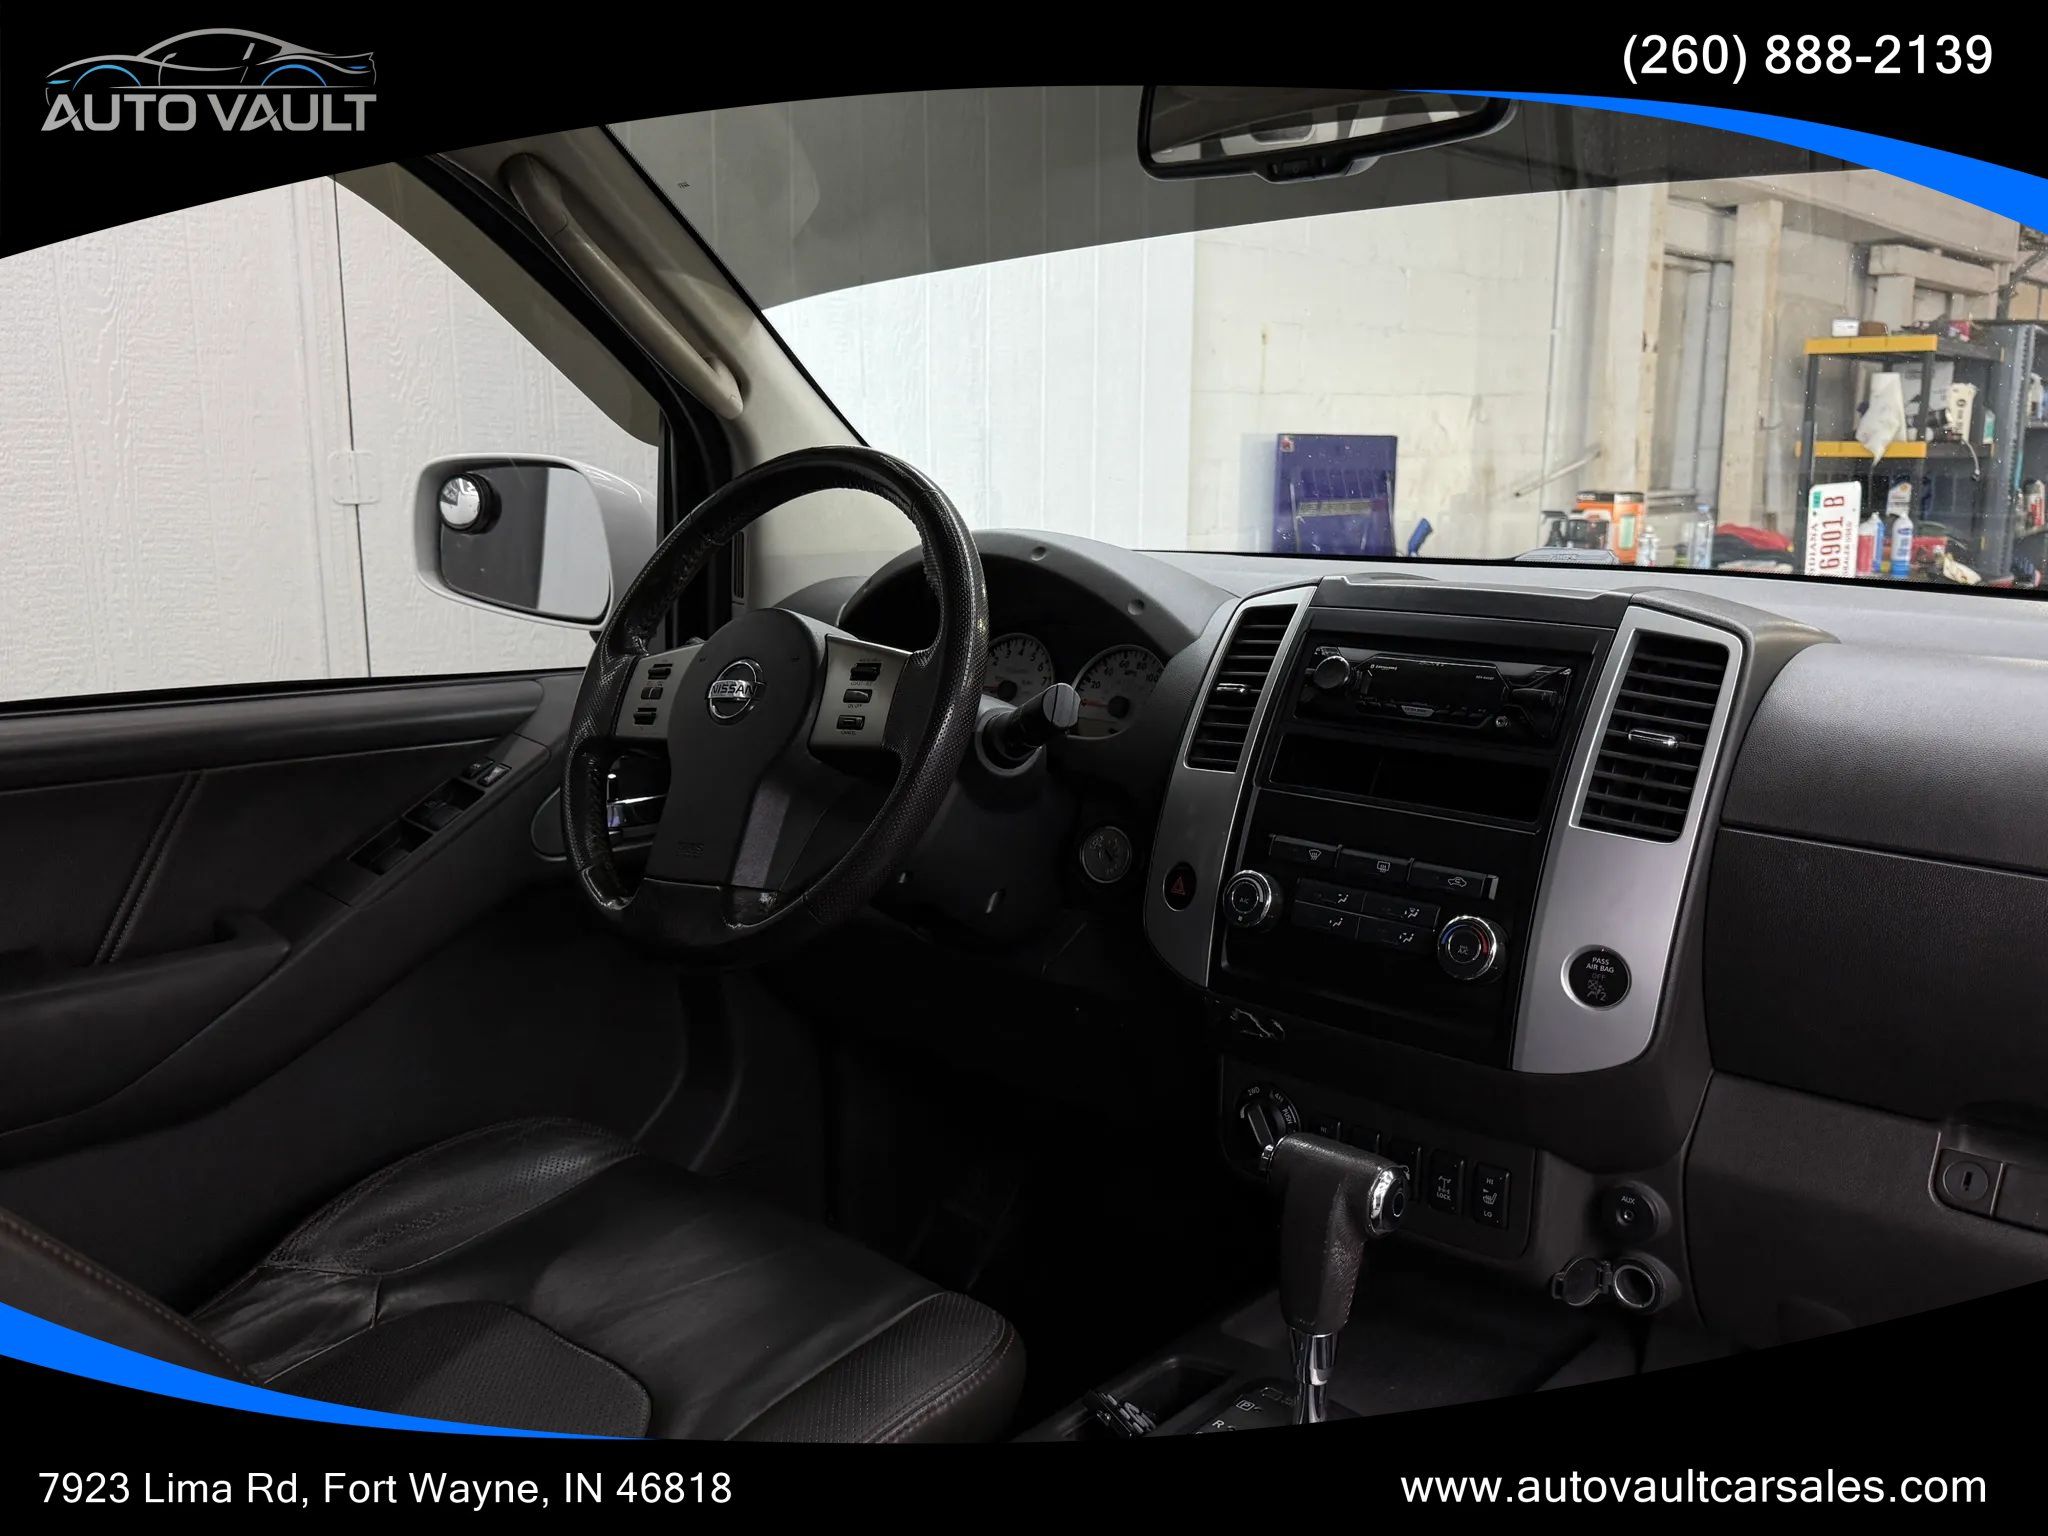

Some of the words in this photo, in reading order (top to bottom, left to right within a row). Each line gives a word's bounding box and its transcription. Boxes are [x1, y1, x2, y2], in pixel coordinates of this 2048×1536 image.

[1823, 495, 1845, 508] B
[1818, 517, 1844, 570] 6901
[1119, 659, 1130, 669] 60
[1136, 662, 1147, 671] 80
[1145, 672, 1159, 682] 100
[711, 683, 757, 696] NISSAN
[1090, 680, 1101, 689] 20
[1592, 957, 1610, 965] PASS
[1586, 963, 1598, 971] AIR
[1600, 965, 1614, 974] BAG
[1592, 973, 1606, 981] OFF
[1485, 1176, 1495, 1186] HI
[1436, 1191, 1452, 1202] LOCK
[1620, 1194, 1636, 1206] AUX
[1483, 1209, 1494, 1219] LO
[1212, 1420, 1225, 1428] R
